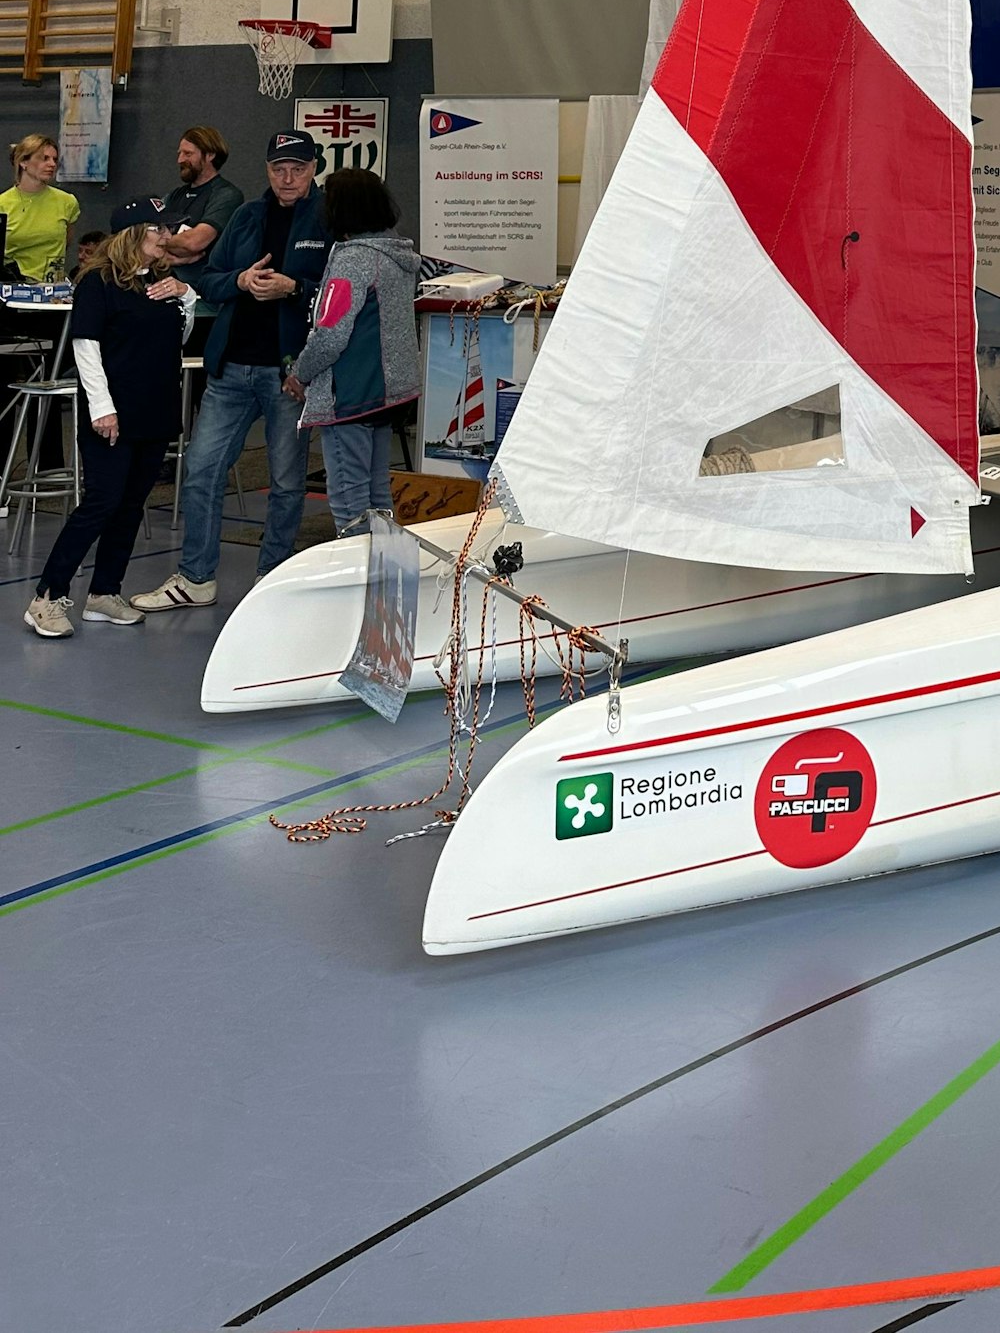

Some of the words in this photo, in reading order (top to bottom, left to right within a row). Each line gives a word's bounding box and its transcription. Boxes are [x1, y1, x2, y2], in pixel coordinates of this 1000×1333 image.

[430, 143, 463, 151] Segel-Club
[464, 143, 496, 151] Rhein-Sieg
[435, 171, 492, 182] Ausbildung
[496, 171, 509, 180] im
[512, 171, 543, 180] SCRS!
[621, 767, 716, 797] Regione
[621, 784, 742, 819] Lombardia
[769, 798, 850, 817] PASCUCCI
